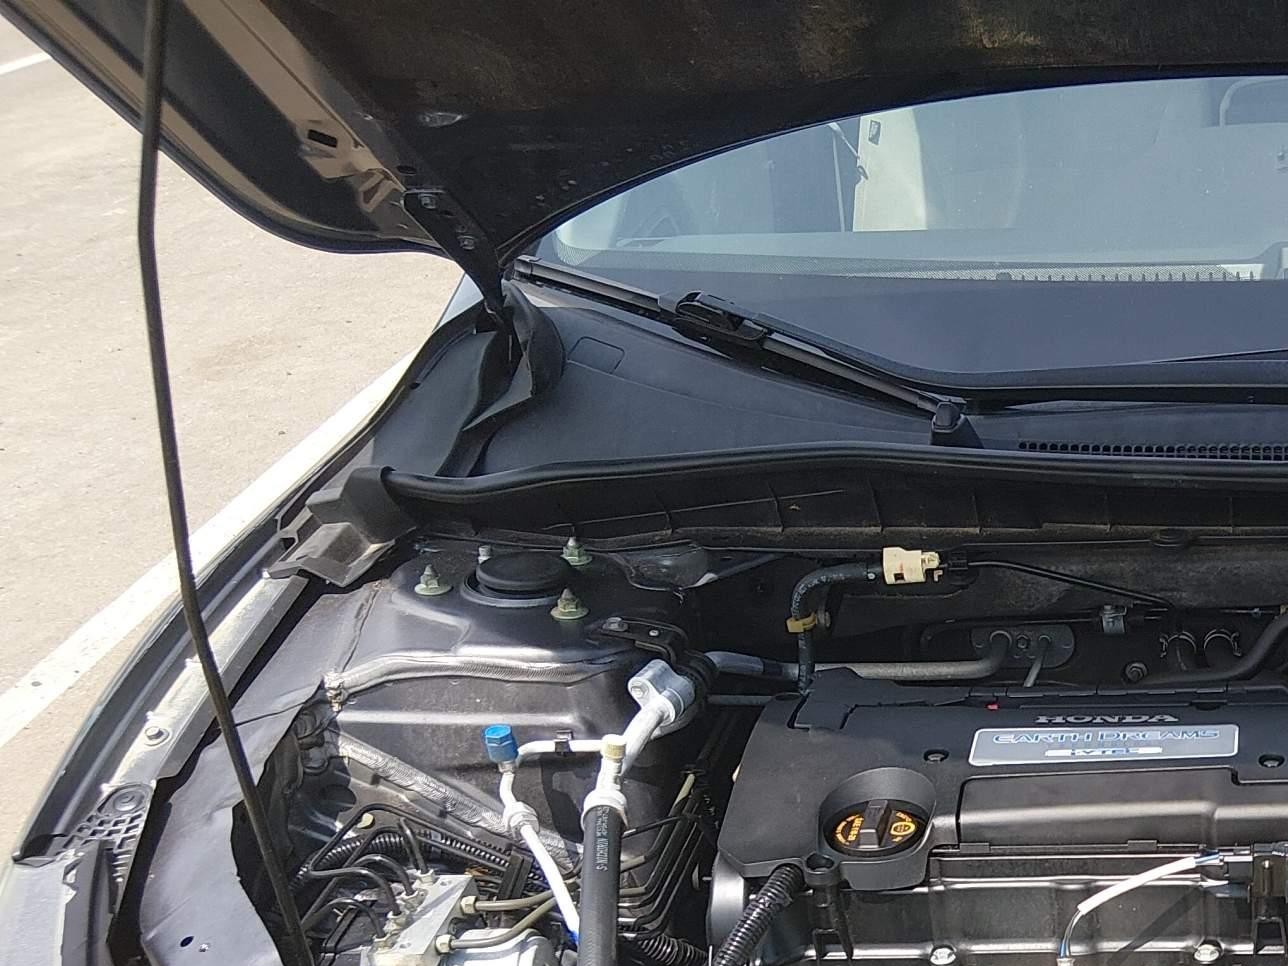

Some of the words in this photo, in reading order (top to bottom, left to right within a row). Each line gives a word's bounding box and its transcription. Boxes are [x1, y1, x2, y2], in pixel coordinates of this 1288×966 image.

[1035, 715, 1179, 723] HONDA
[993, 732, 1092, 744] EARTH
[1098, 729, 1220, 742] DREAMS
